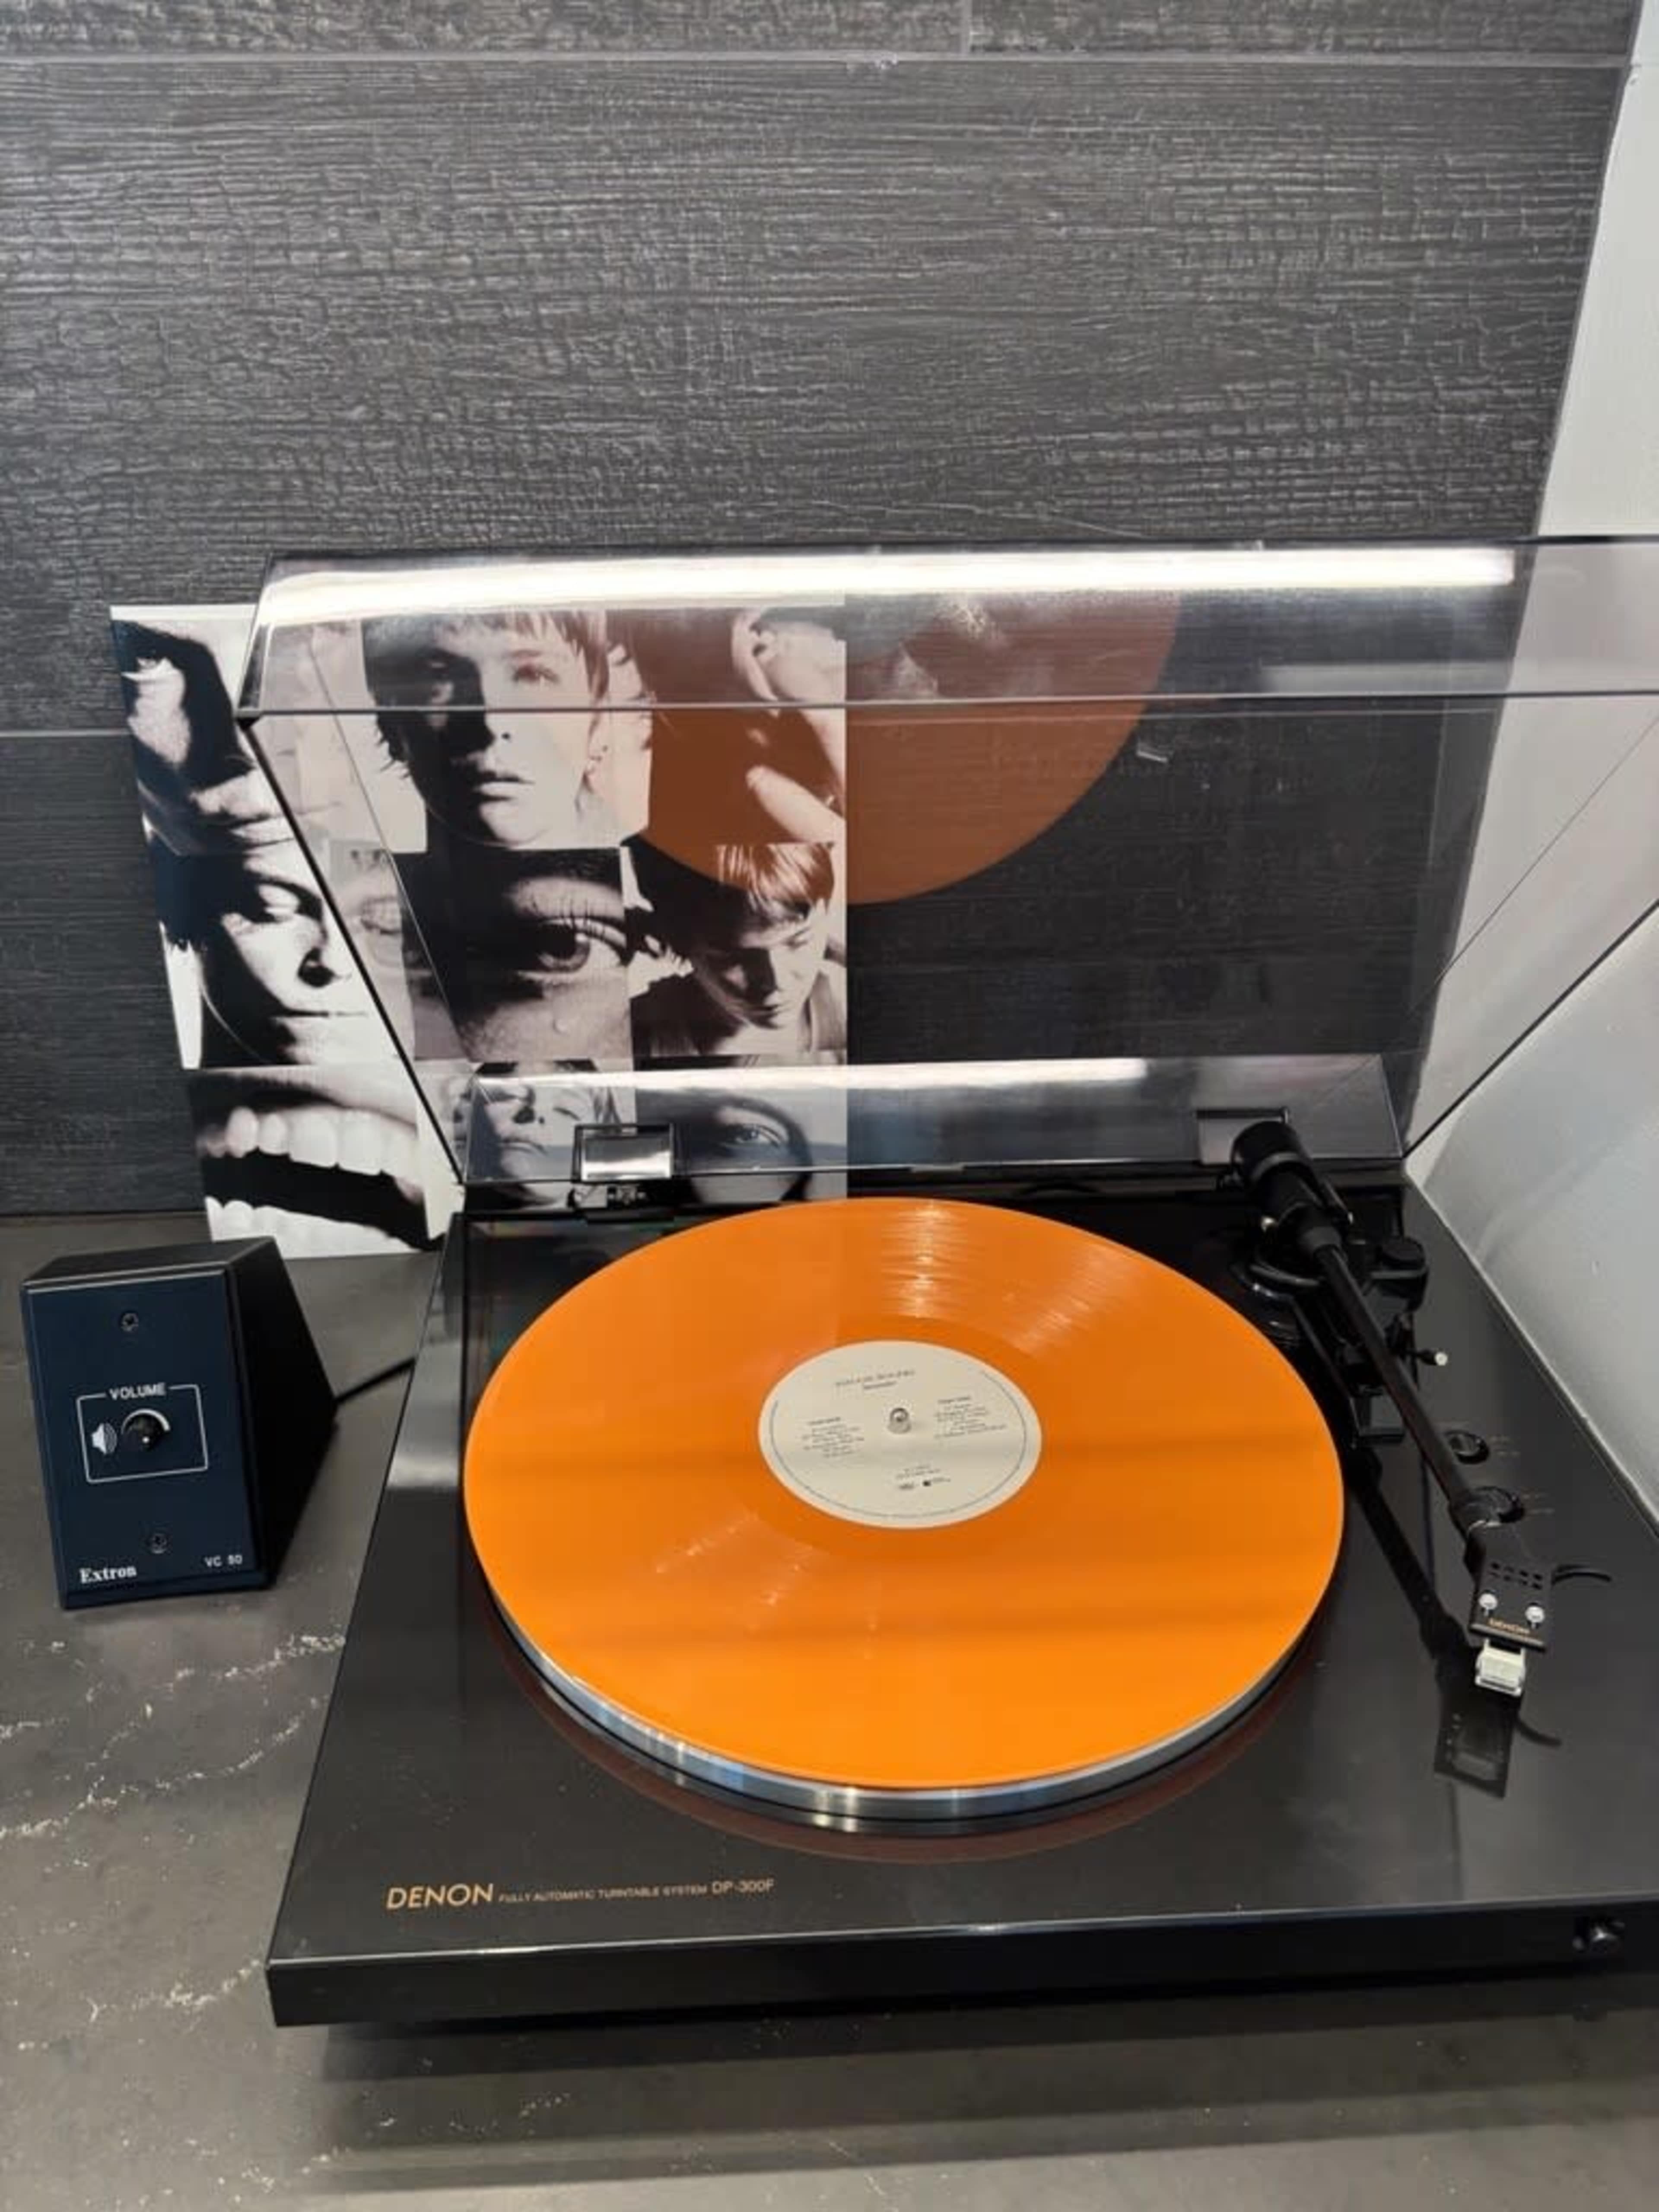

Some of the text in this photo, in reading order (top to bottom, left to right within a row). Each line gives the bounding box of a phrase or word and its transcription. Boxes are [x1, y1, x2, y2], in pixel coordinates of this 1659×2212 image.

[109, 1382, 166, 1401] VOLUME
[204, 1555, 222, 1567] VC
[79, 1565, 137, 1584] Extron
[386, 1878, 774, 1910] DENON FULLY AUTOMATIC TURNTABLE SYSTEM DP-300F
